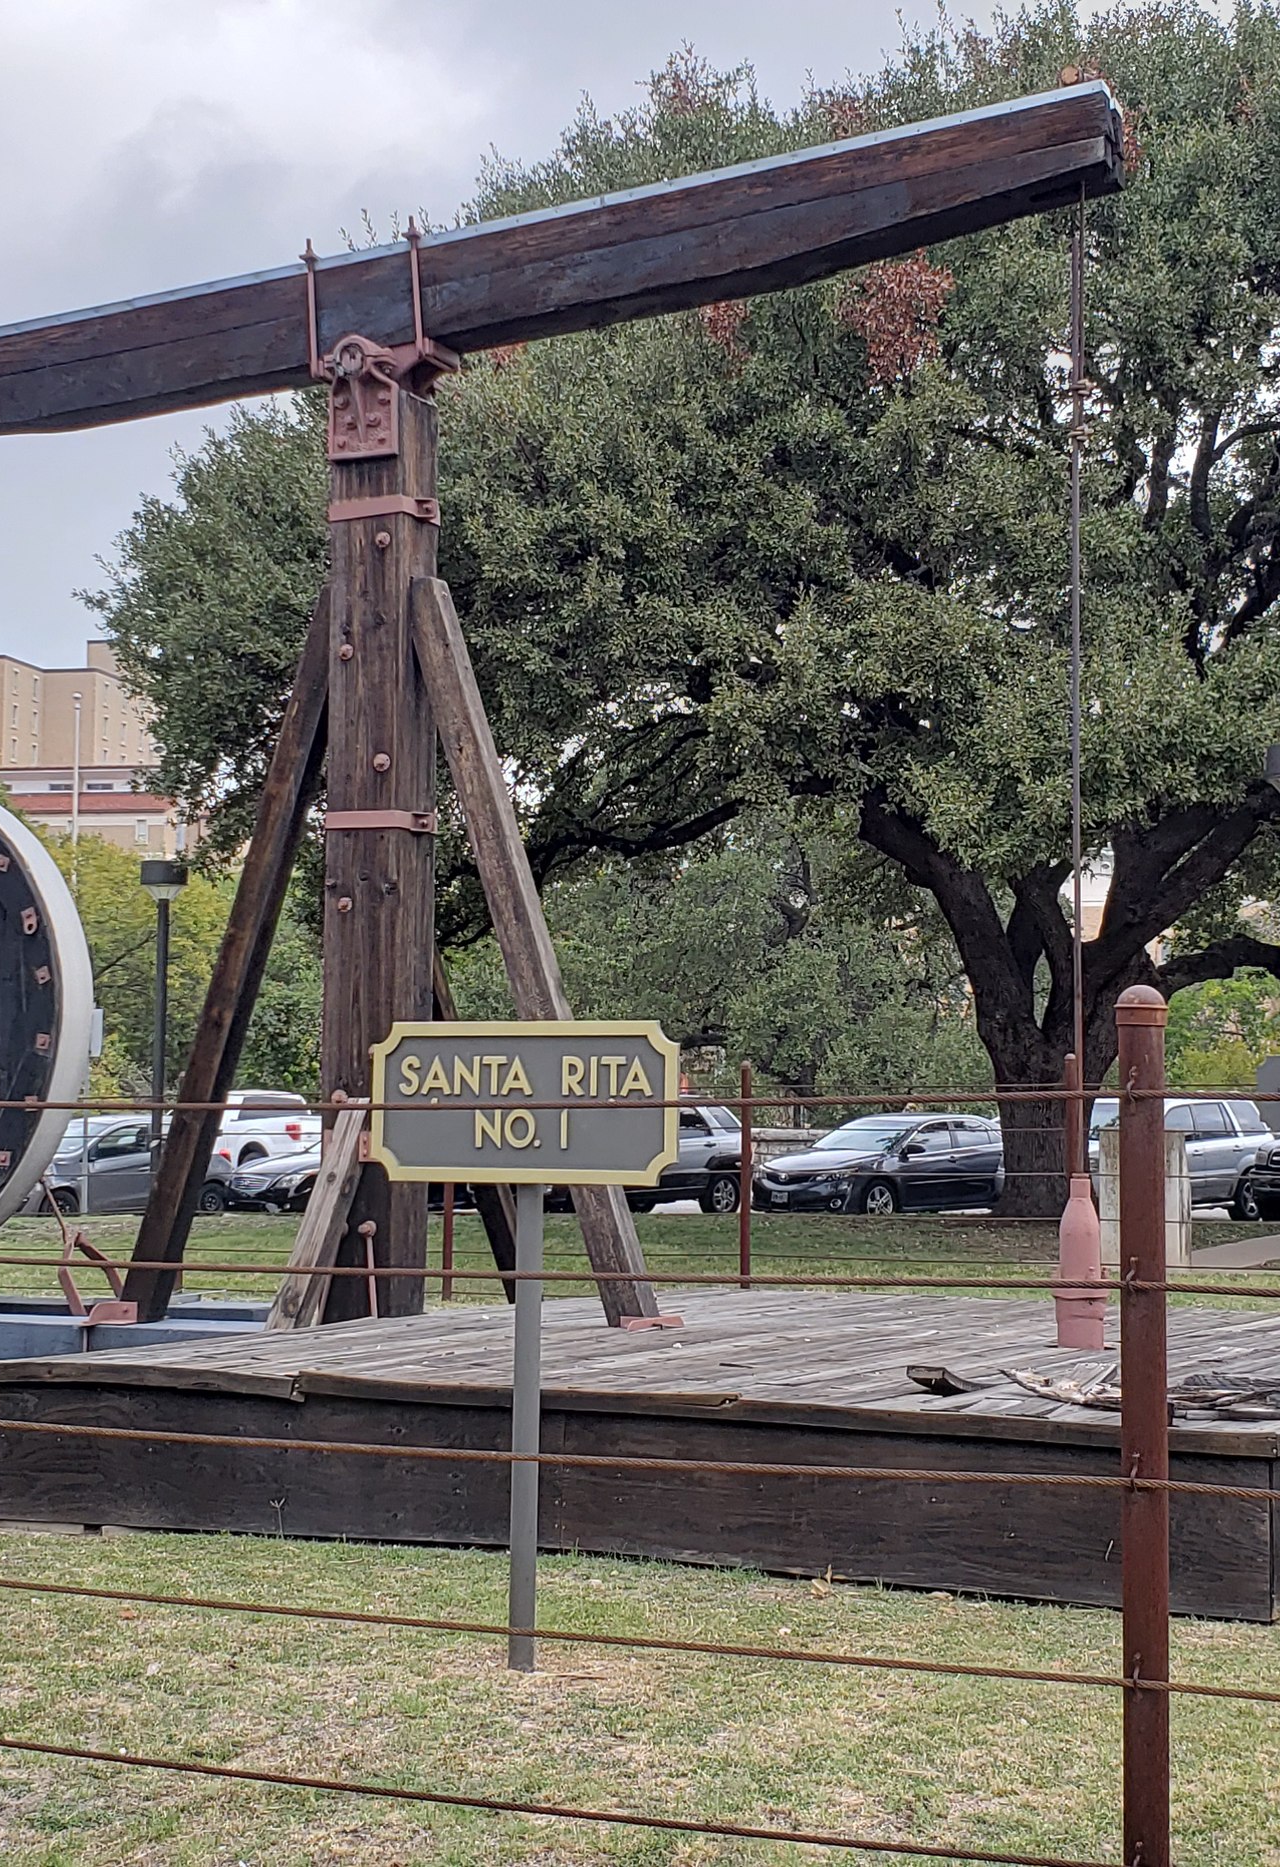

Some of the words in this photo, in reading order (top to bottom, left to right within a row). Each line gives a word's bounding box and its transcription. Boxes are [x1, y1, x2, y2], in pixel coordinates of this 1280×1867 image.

[399, 1055, 533, 1096] SANTA
[561, 1055, 653, 1097] RITA
[474, 1108, 541, 1150] NO.
[560, 1109, 569, 1150] 1
